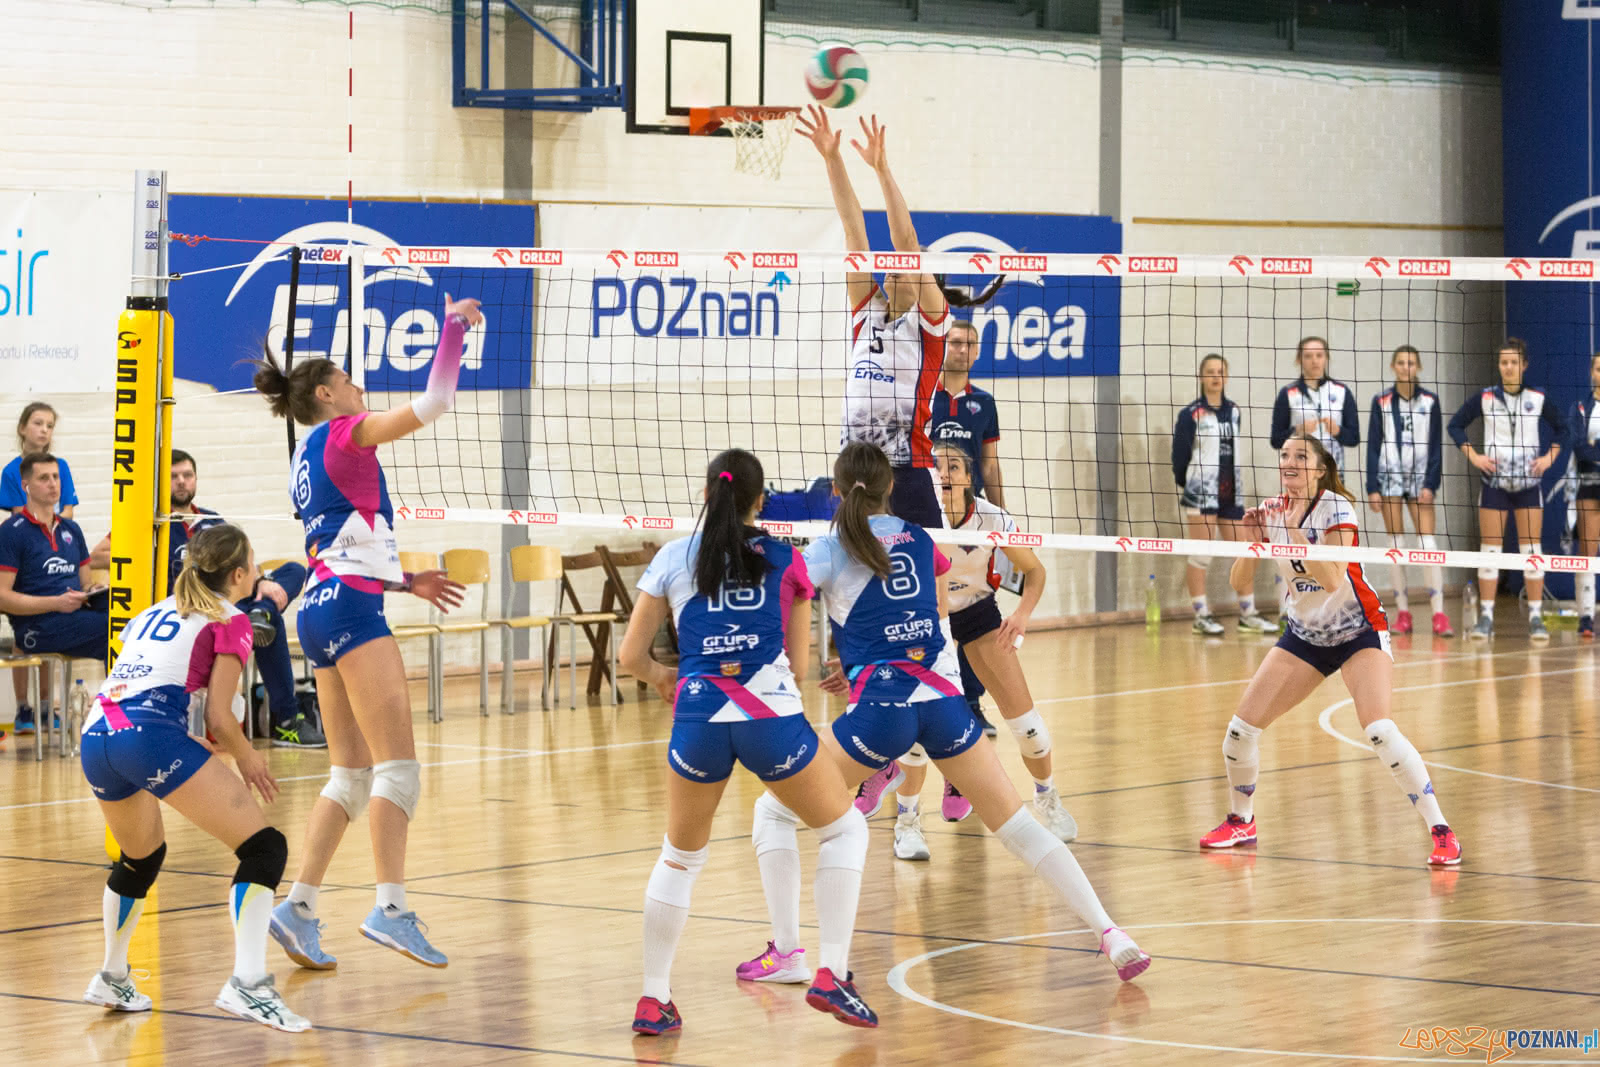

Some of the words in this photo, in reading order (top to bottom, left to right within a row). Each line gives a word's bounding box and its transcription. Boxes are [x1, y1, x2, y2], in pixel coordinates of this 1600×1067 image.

[410, 250, 448, 263] ORLEN
[522, 251, 560, 264] ORLEN
[636, 253, 676, 266] ORLEN
[754, 254, 796, 267] ORLEN
[876, 255, 918, 269] ORLEN
[1002, 257, 1046, 271] ORLEN
[1130, 258, 1176, 272] ORLEN
[1262, 259, 1310, 274] ORLEN
[1400, 260, 1450, 275] ORLEN
[1542, 261, 1592, 276] ORLEN
[946, 286, 1087, 361] nea
[869, 326, 885, 354] 5
[854, 368, 895, 383] Enea
[940, 428, 972, 439] Enea
[417, 510, 444, 518] ORLEN
[528, 514, 556, 523] ORLEN
[644, 519, 672, 528] ORLEN
[1010, 535, 1041, 545] ORLEN
[1139, 541, 1171, 551] ORLEN
[1273, 546, 1306, 556] ORLEN
[1410, 553, 1444, 563] ORLEN
[1552, 559, 1587, 570] ORLEN
[47, 564, 75, 575] Enea
[1296, 582, 1325, 592] Ene
[136, 609, 180, 641] 16
